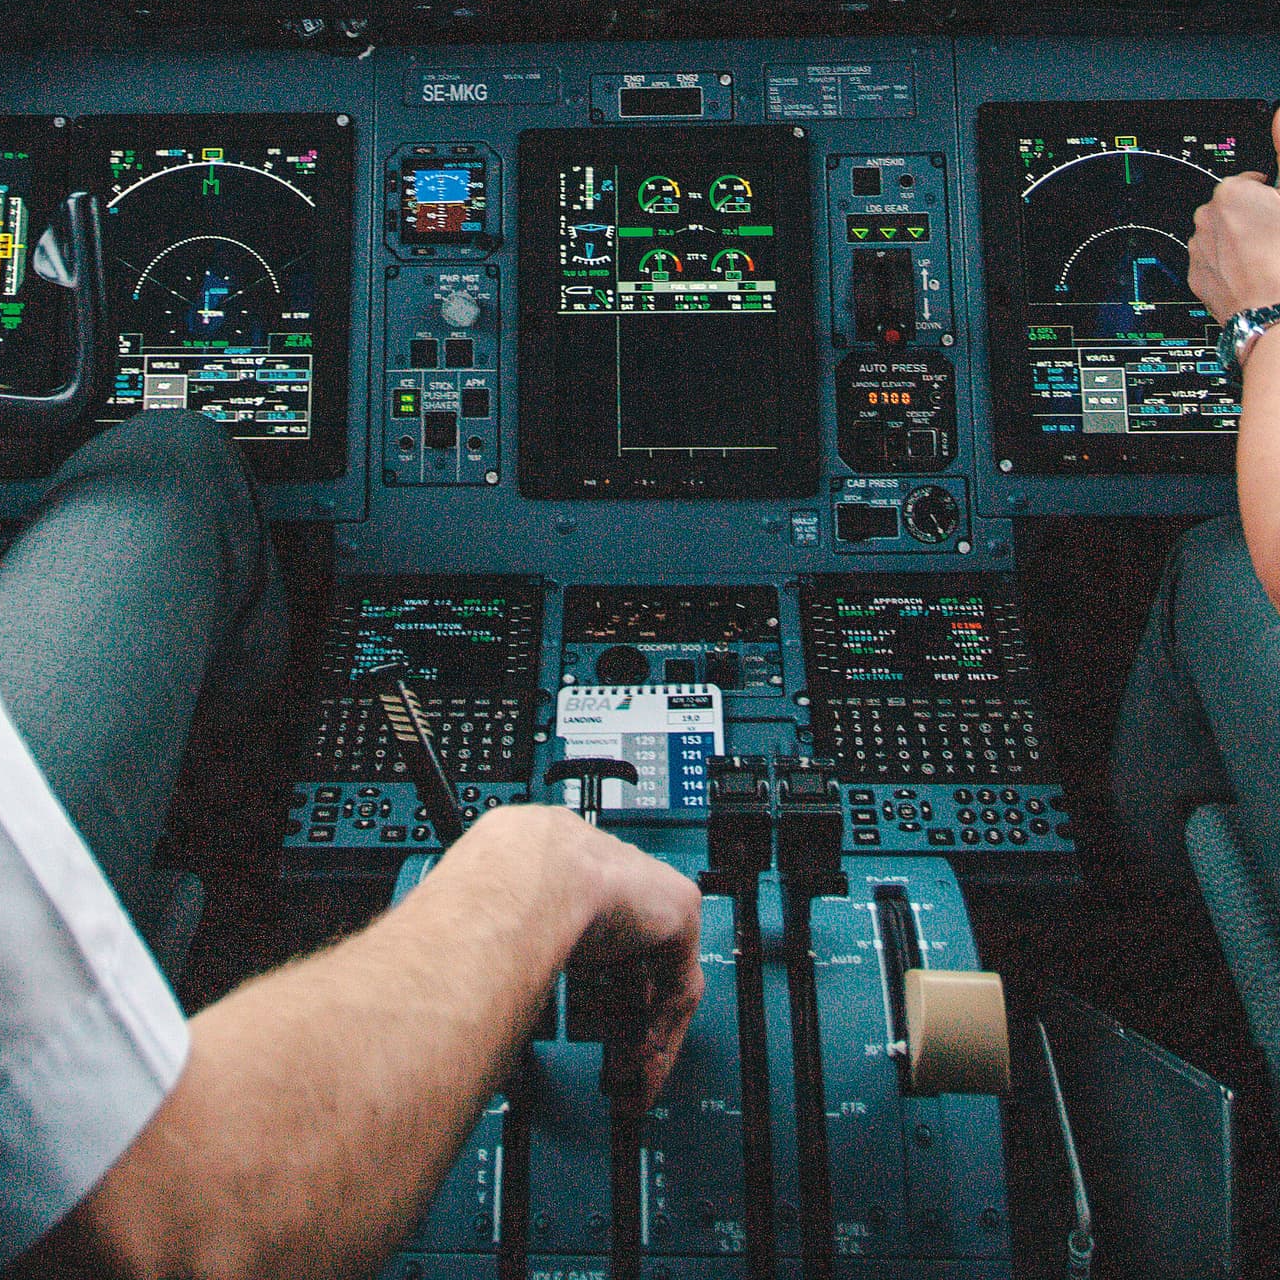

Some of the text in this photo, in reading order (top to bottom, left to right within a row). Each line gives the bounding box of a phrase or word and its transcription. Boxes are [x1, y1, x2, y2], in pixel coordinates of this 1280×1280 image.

[624, 75, 645, 84] ENG1
[677, 74, 699, 84] ENG2
[422, 83, 488, 102] SE-MKG
[866, 158, 905, 167] ANTISKID
[866, 203, 910, 213] LDG GEAR
[440, 274, 480, 283] PWR MGT
[915, 322, 941, 331] DOWN
[859, 363, 929, 374] AUTO PRESS
[429, 381, 454, 391] STICK
[881, 381, 917, 389] ELEVATION
[423, 391, 460, 401] PUSHER
[423, 400, 460, 411] SHAKER
[847, 478, 900, 488] CAB PRESS
[951, 622, 983, 630] ICING
[637, 644, 677, 652] COCKPIT
[564, 696, 612, 711] BRA
[563, 716, 603, 724] LANDING
[635, 737, 656, 746] 129
[681, 736, 703, 745] 153
[681, 751, 702, 760] 121
[682, 766, 703, 775] 110
[682, 781, 703, 791] 114
[682, 796, 704, 806] 121
[866, 875, 910, 884] FLAPS
[830, 954, 863, 966] AUTO
